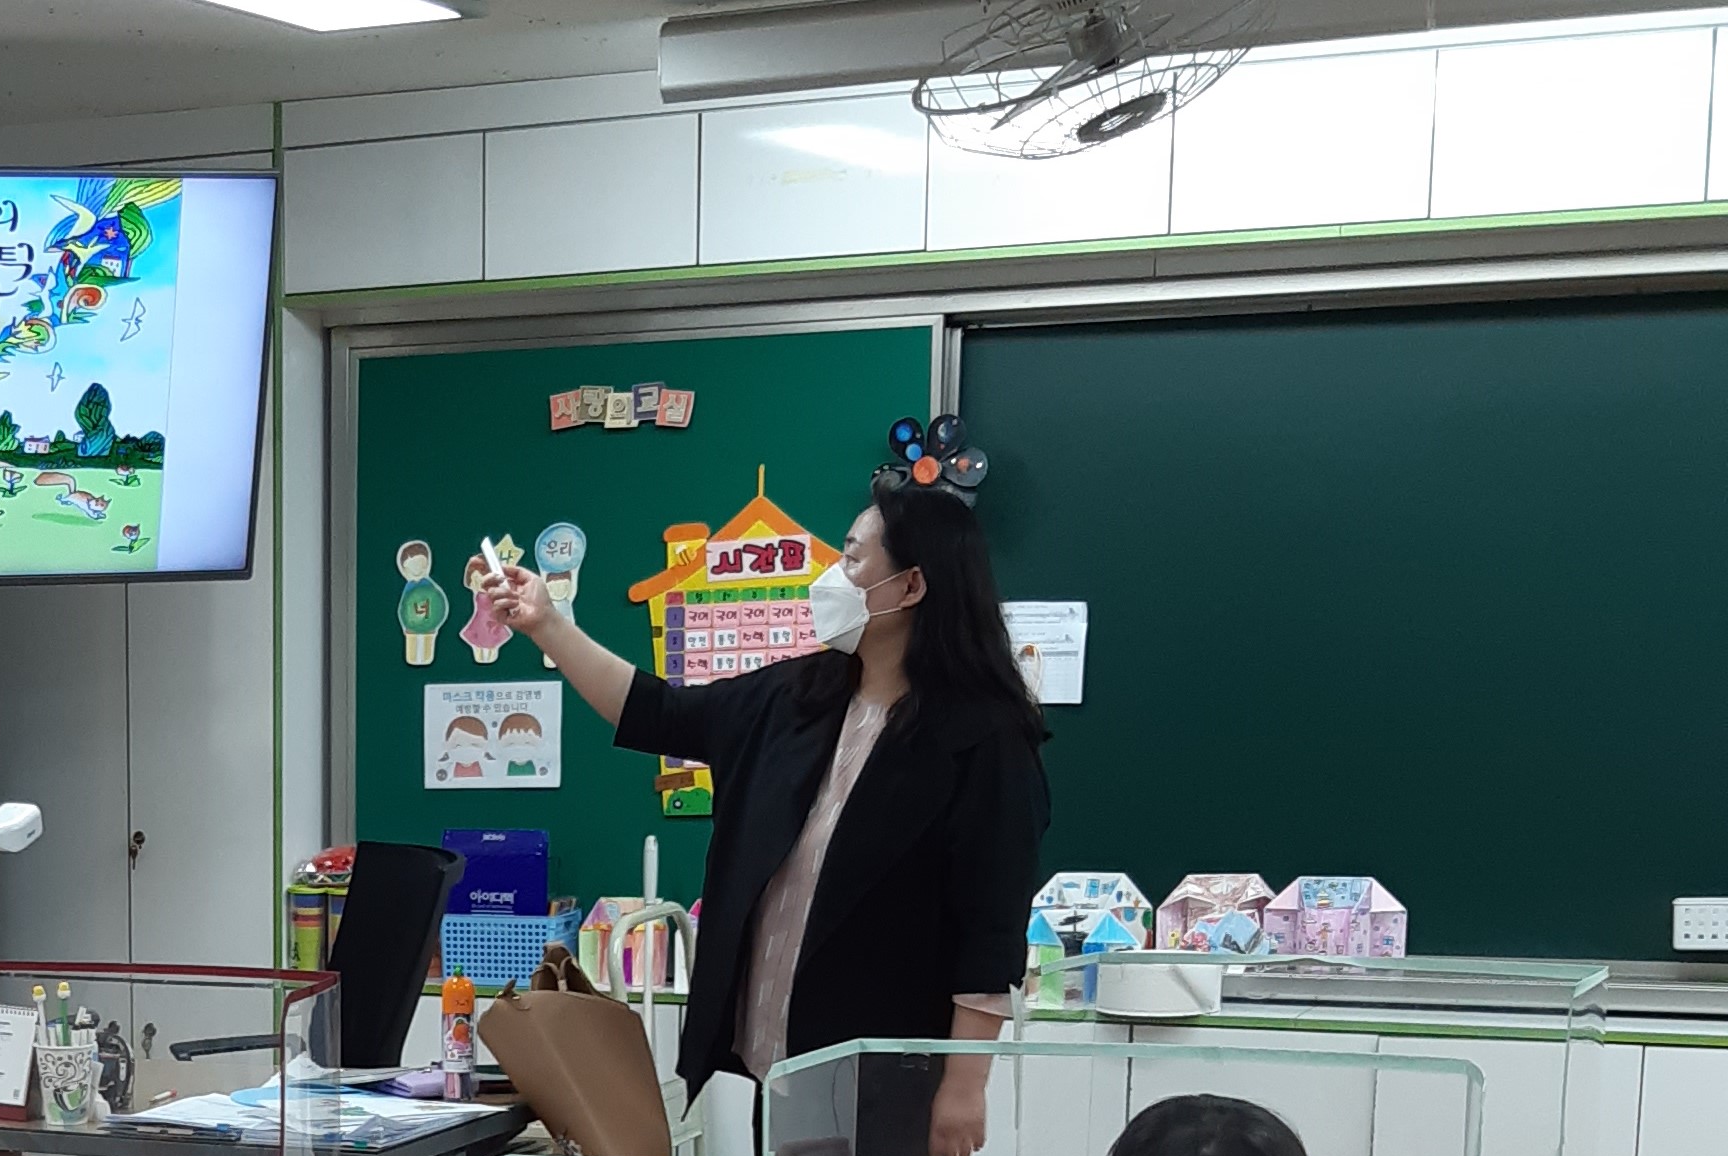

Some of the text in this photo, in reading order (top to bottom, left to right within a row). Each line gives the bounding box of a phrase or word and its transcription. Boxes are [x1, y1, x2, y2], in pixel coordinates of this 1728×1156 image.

[545, 540, 573, 557] 우리
[499, 549, 514, 564] 나
[710, 539, 806, 575] 시간표
[688, 610, 709, 622] 국어
[716, 610, 738, 622] 국어
[743, 607, 765, 619] 국어
[772, 607, 794, 618] 국어
[443, 691, 473, 702] 마스크
[483, 703, 492, 713] 수
[493, 702, 528, 713] 있습니다
